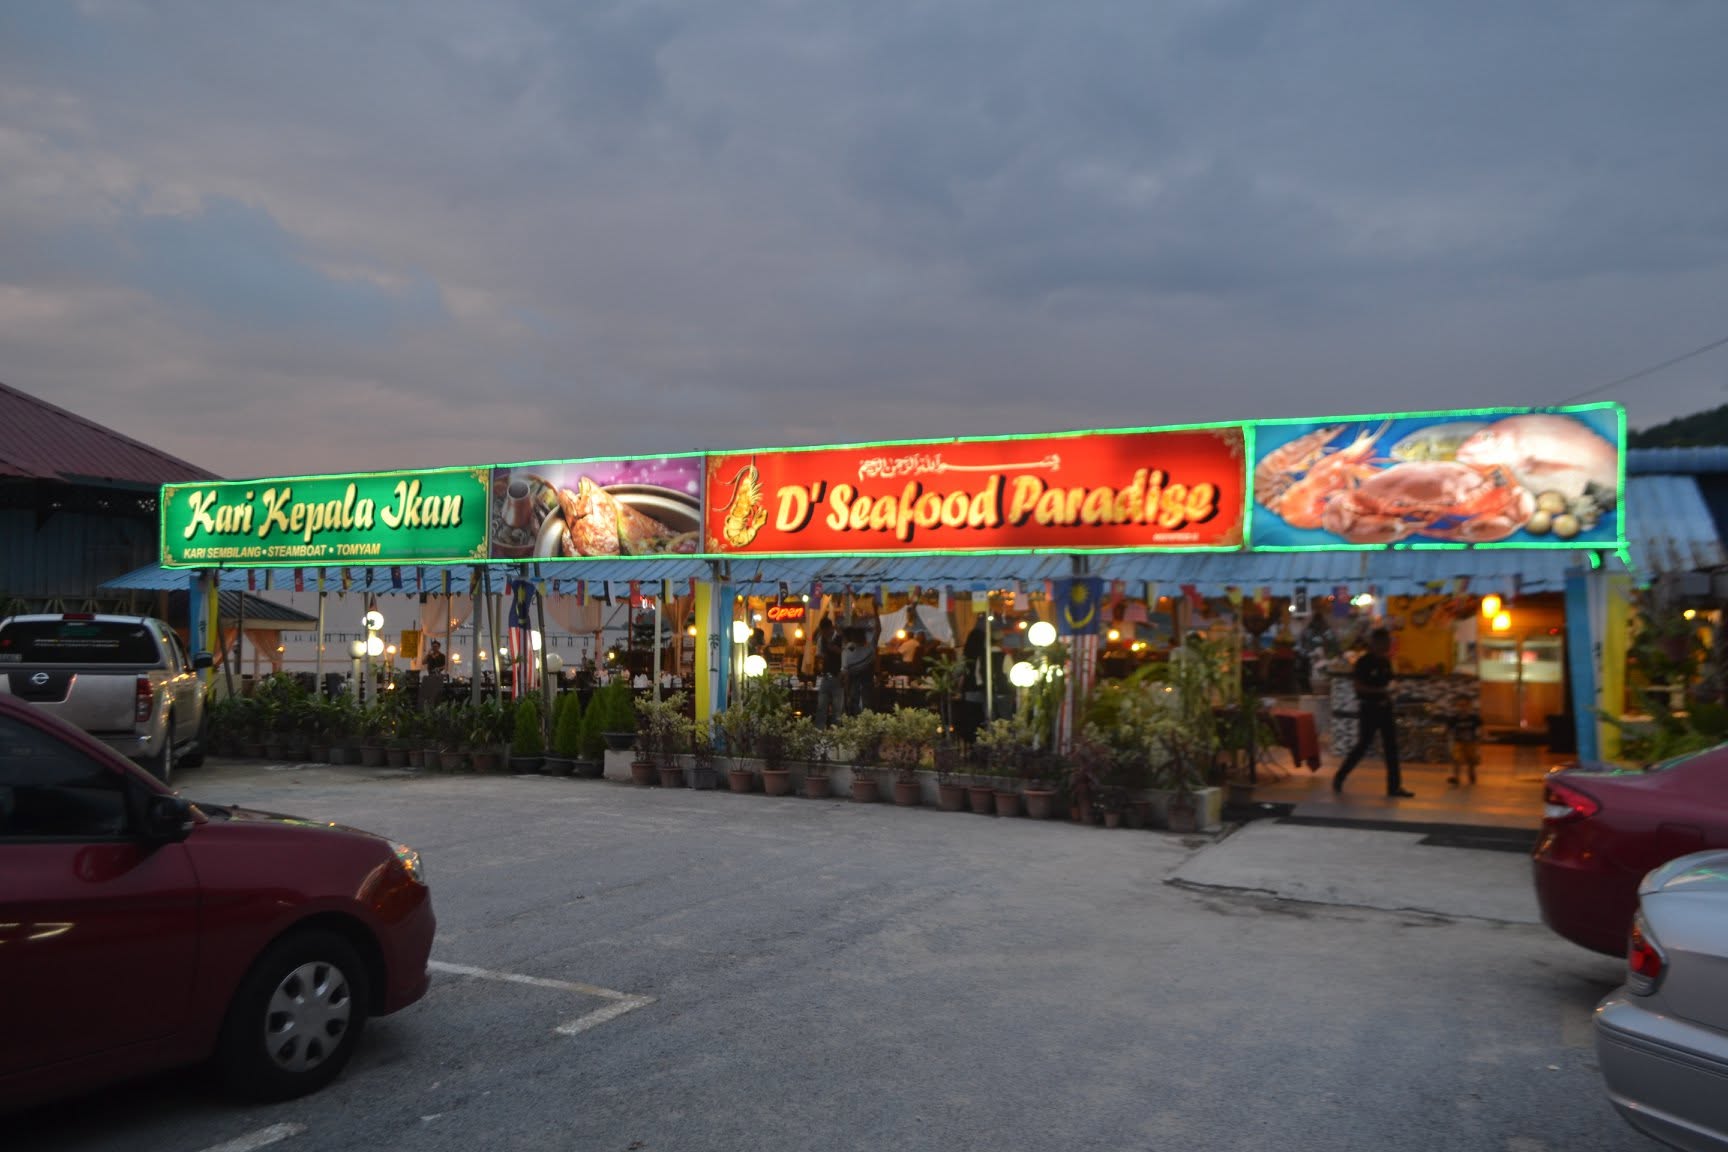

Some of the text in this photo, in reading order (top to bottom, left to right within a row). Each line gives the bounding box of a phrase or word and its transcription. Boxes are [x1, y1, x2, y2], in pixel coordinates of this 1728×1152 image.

[183, 479, 463, 543] Kari Kepala Ikan
[1008, 468, 1216, 529] Paradise
[183, 543, 381, 559] KARI SEMBILANG STEAMBOAT TOMYAM
[767, 606, 805, 621] Open
